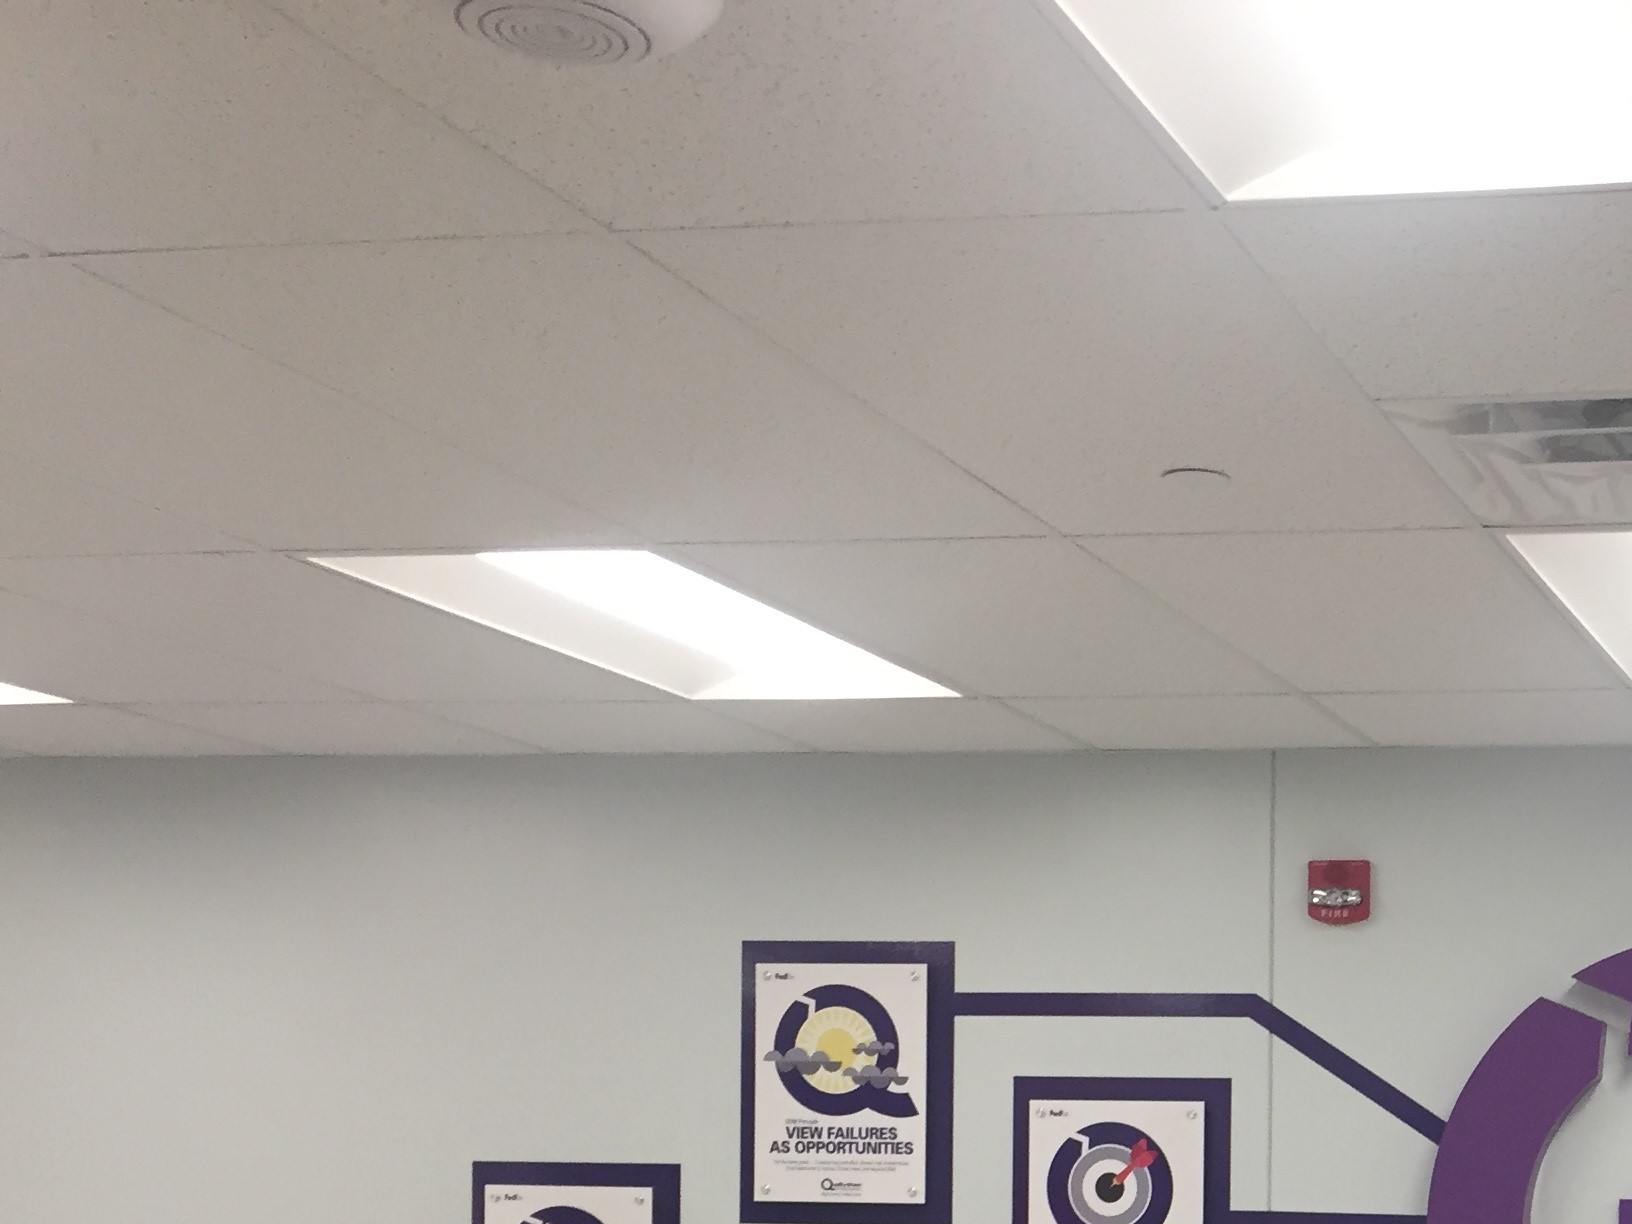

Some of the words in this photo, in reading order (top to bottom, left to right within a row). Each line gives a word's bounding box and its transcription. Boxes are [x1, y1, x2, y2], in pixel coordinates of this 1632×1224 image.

[785, 1126, 823, 1139] VIEW
[827, 1126, 898, 1140] FAILURES
[769, 1140, 790, 1154] AS
[794, 1141, 914, 1155] OPPORTUNITIES
